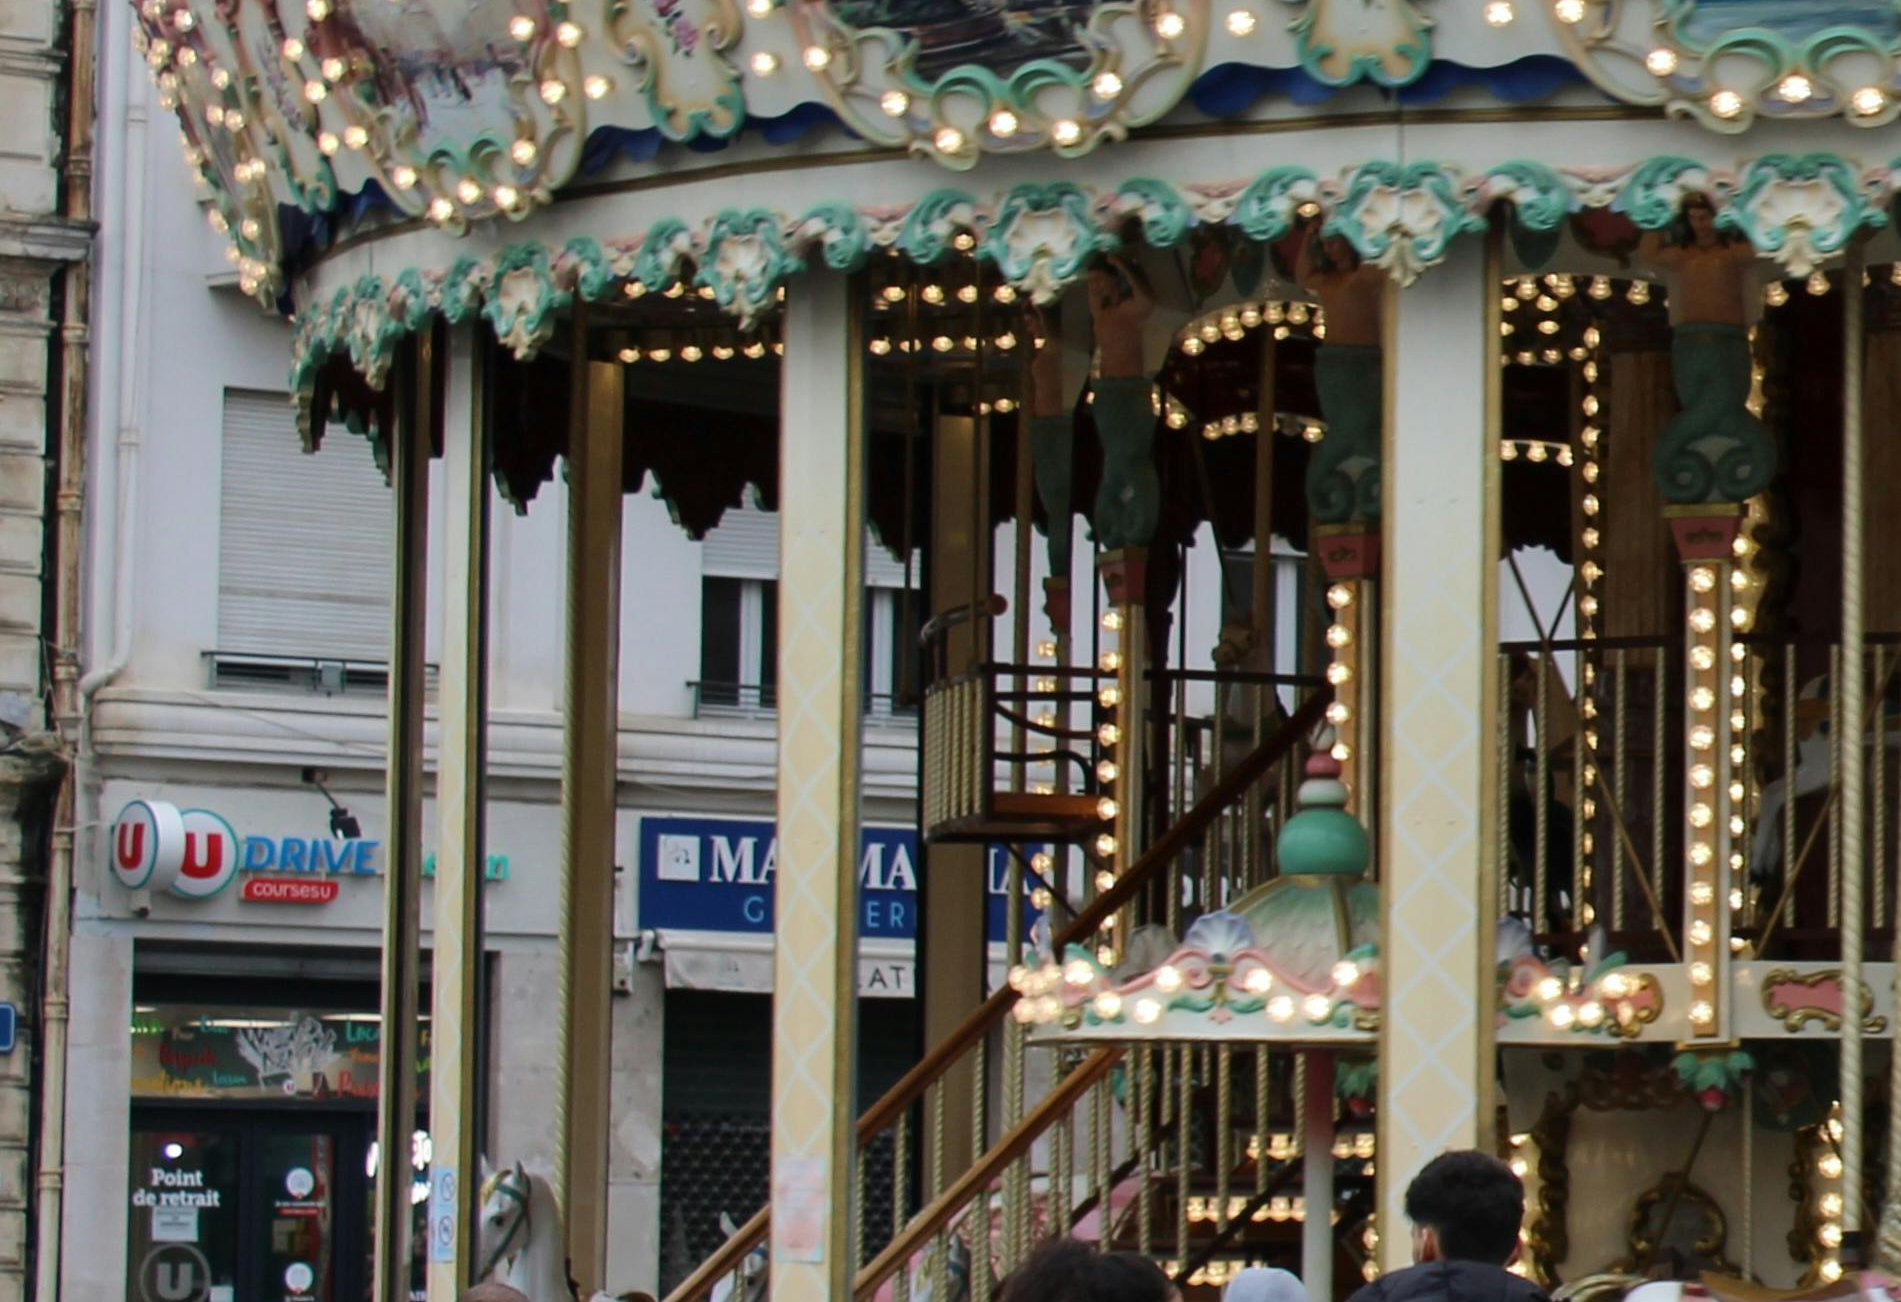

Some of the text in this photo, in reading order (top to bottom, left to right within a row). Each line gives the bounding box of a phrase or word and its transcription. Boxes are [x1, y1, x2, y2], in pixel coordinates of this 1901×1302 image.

[117, 823, 144, 870] U
[181, 833, 222, 878] U
[244, 835, 380, 875] DRIVE
[151, 1168, 204, 1188] Point
[133, 1190, 220, 1208] de retrait
